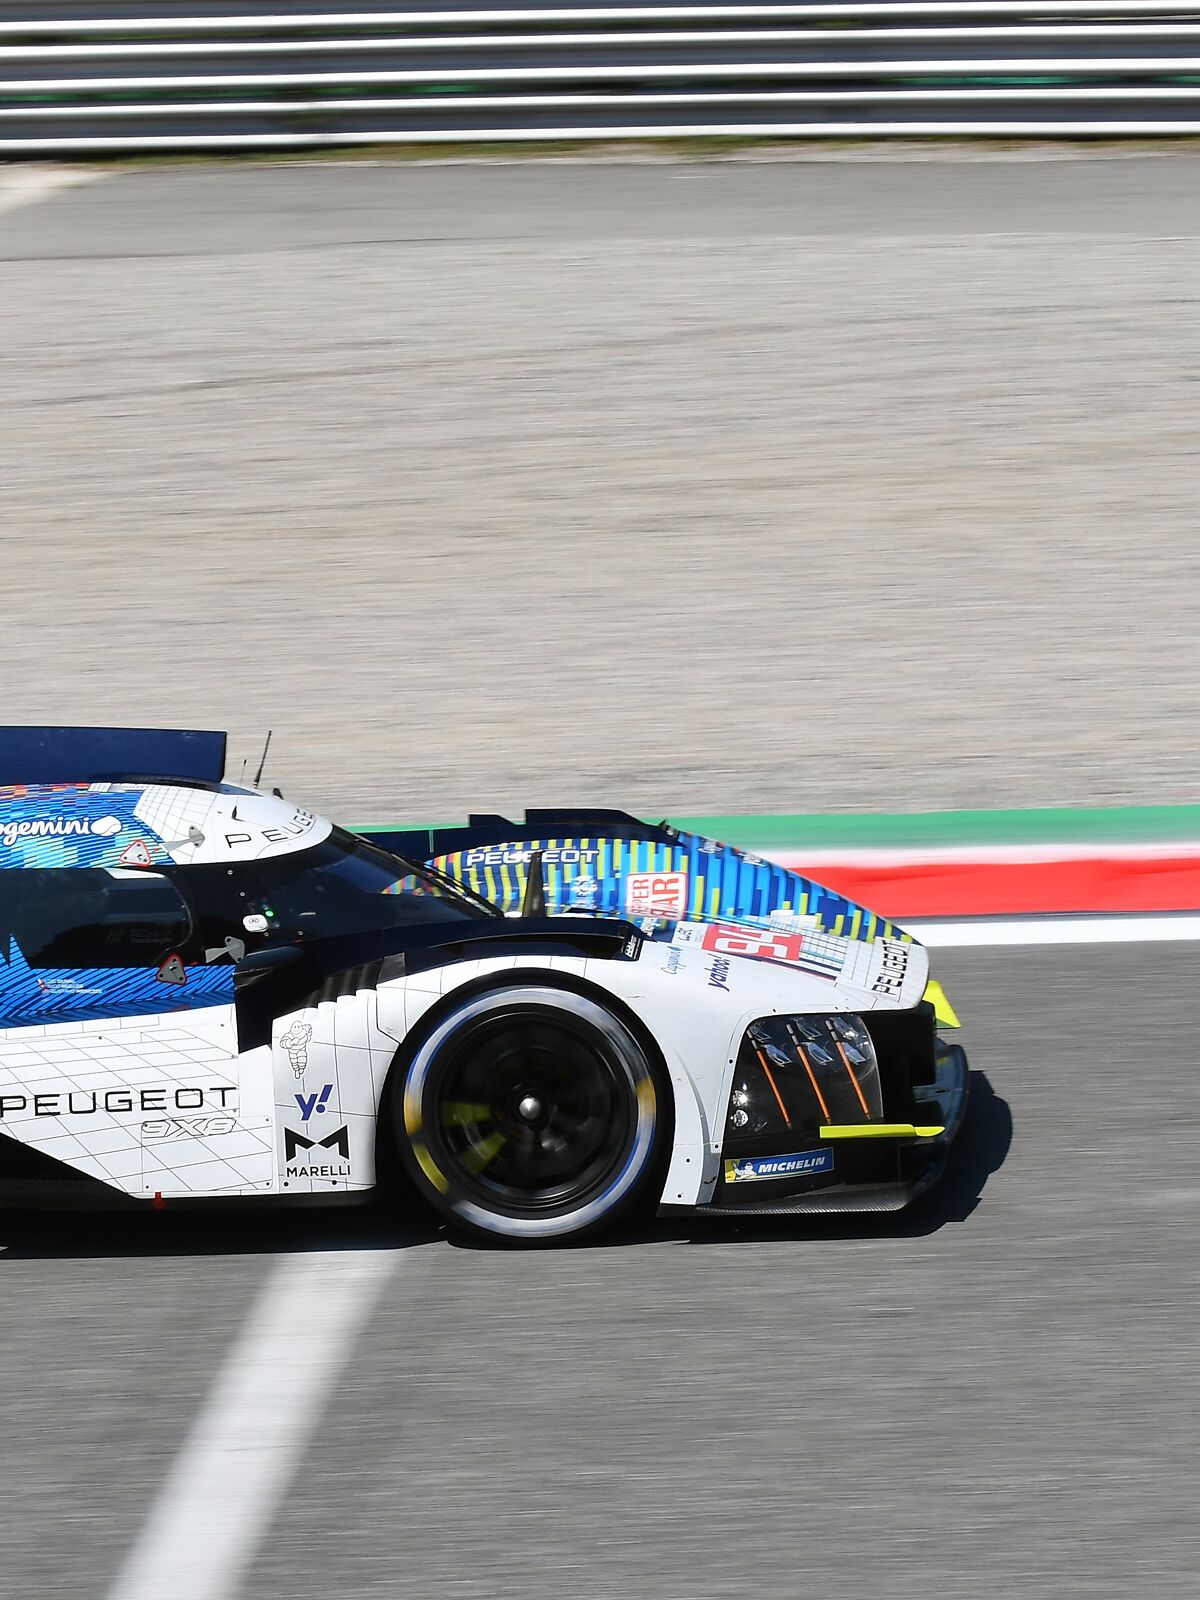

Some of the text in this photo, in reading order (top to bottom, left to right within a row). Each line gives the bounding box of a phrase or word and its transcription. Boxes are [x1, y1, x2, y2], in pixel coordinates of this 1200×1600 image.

[704, 952, 731, 992] yahoo!
[871, 937, 910, 996] PEUGEOT
[0, 1087, 238, 1118] PEUGEOT
[141, 1118, 238, 1138] 9X8
[286, 1165, 351, 1178] MARELLI
[757, 1156, 826, 1174] MICHELIN
